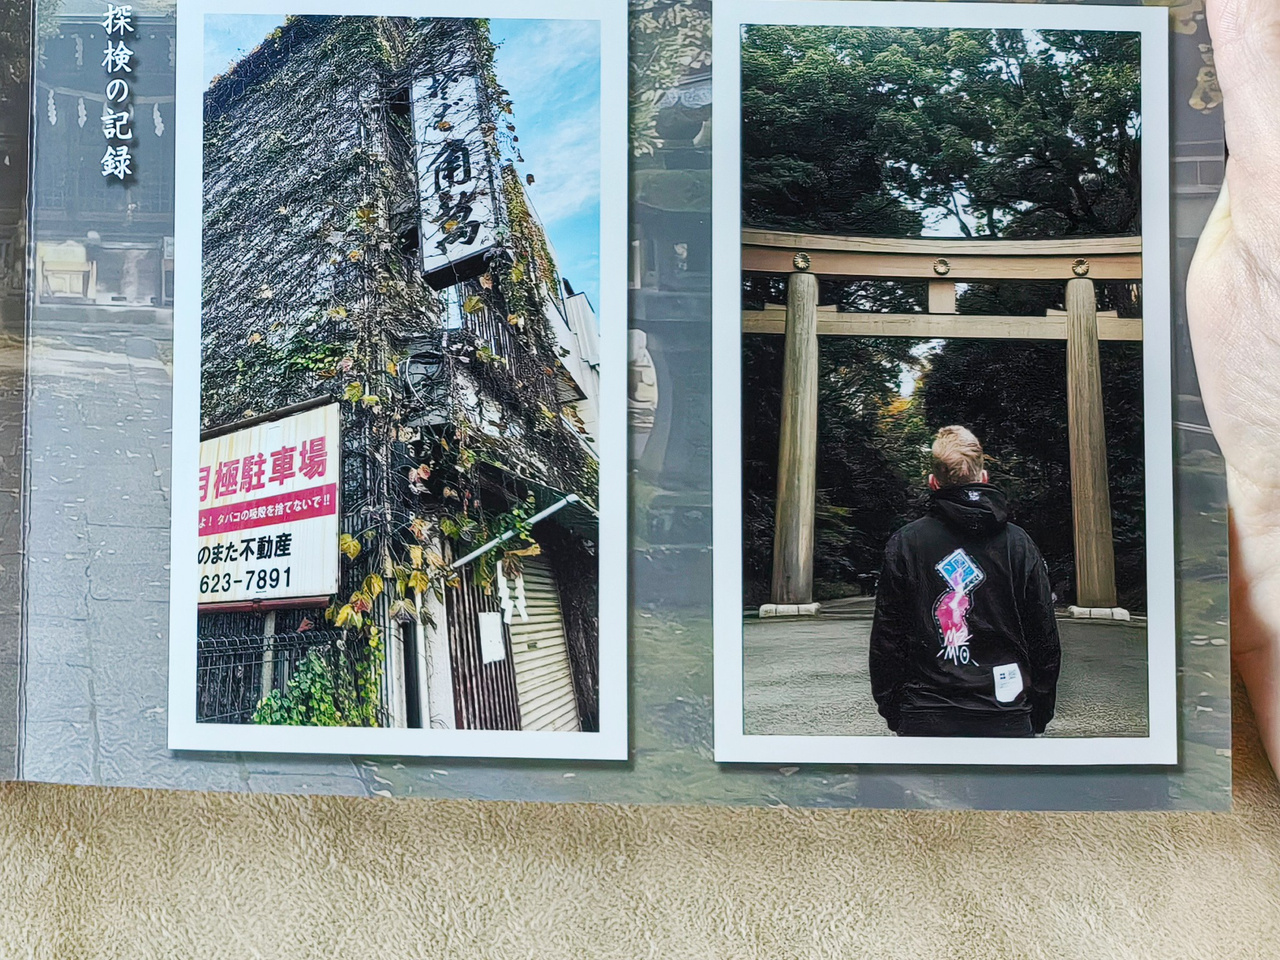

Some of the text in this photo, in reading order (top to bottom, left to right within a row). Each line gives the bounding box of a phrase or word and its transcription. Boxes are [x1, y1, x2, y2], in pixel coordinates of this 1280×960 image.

[100, 3, 135, 180] 探検の記録
[198, 532, 293, 565] のまた不動産
[200, 567, 291, 594] 623-7891
